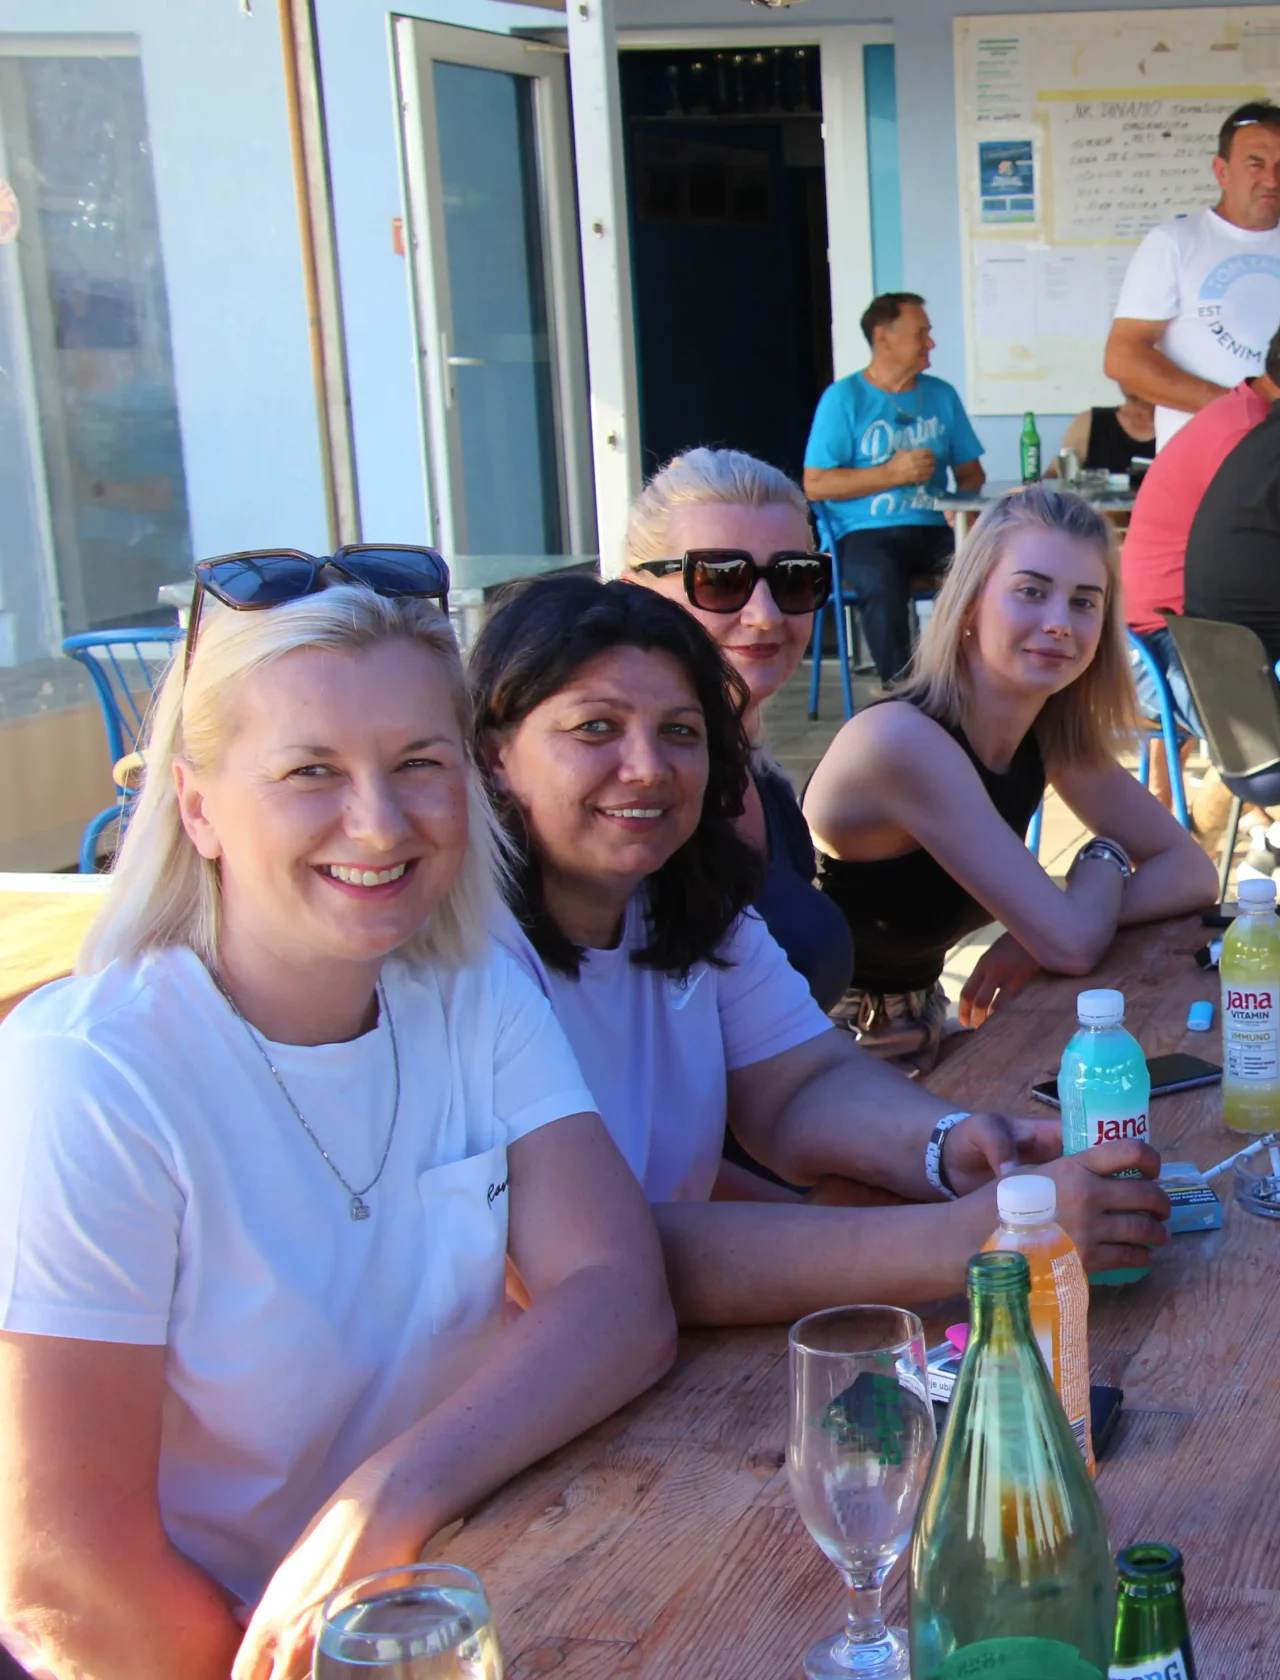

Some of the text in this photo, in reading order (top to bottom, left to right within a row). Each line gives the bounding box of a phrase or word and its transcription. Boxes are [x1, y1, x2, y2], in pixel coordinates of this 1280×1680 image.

[1197, 304, 1222, 317] EST
[1226, 989, 1273, 1011] Jana
[1231, 1010, 1270, 1020] VITAMIN
[1231, 1032, 1270, 1041] IMMUNO
[1093, 1114, 1148, 1146] Jana
